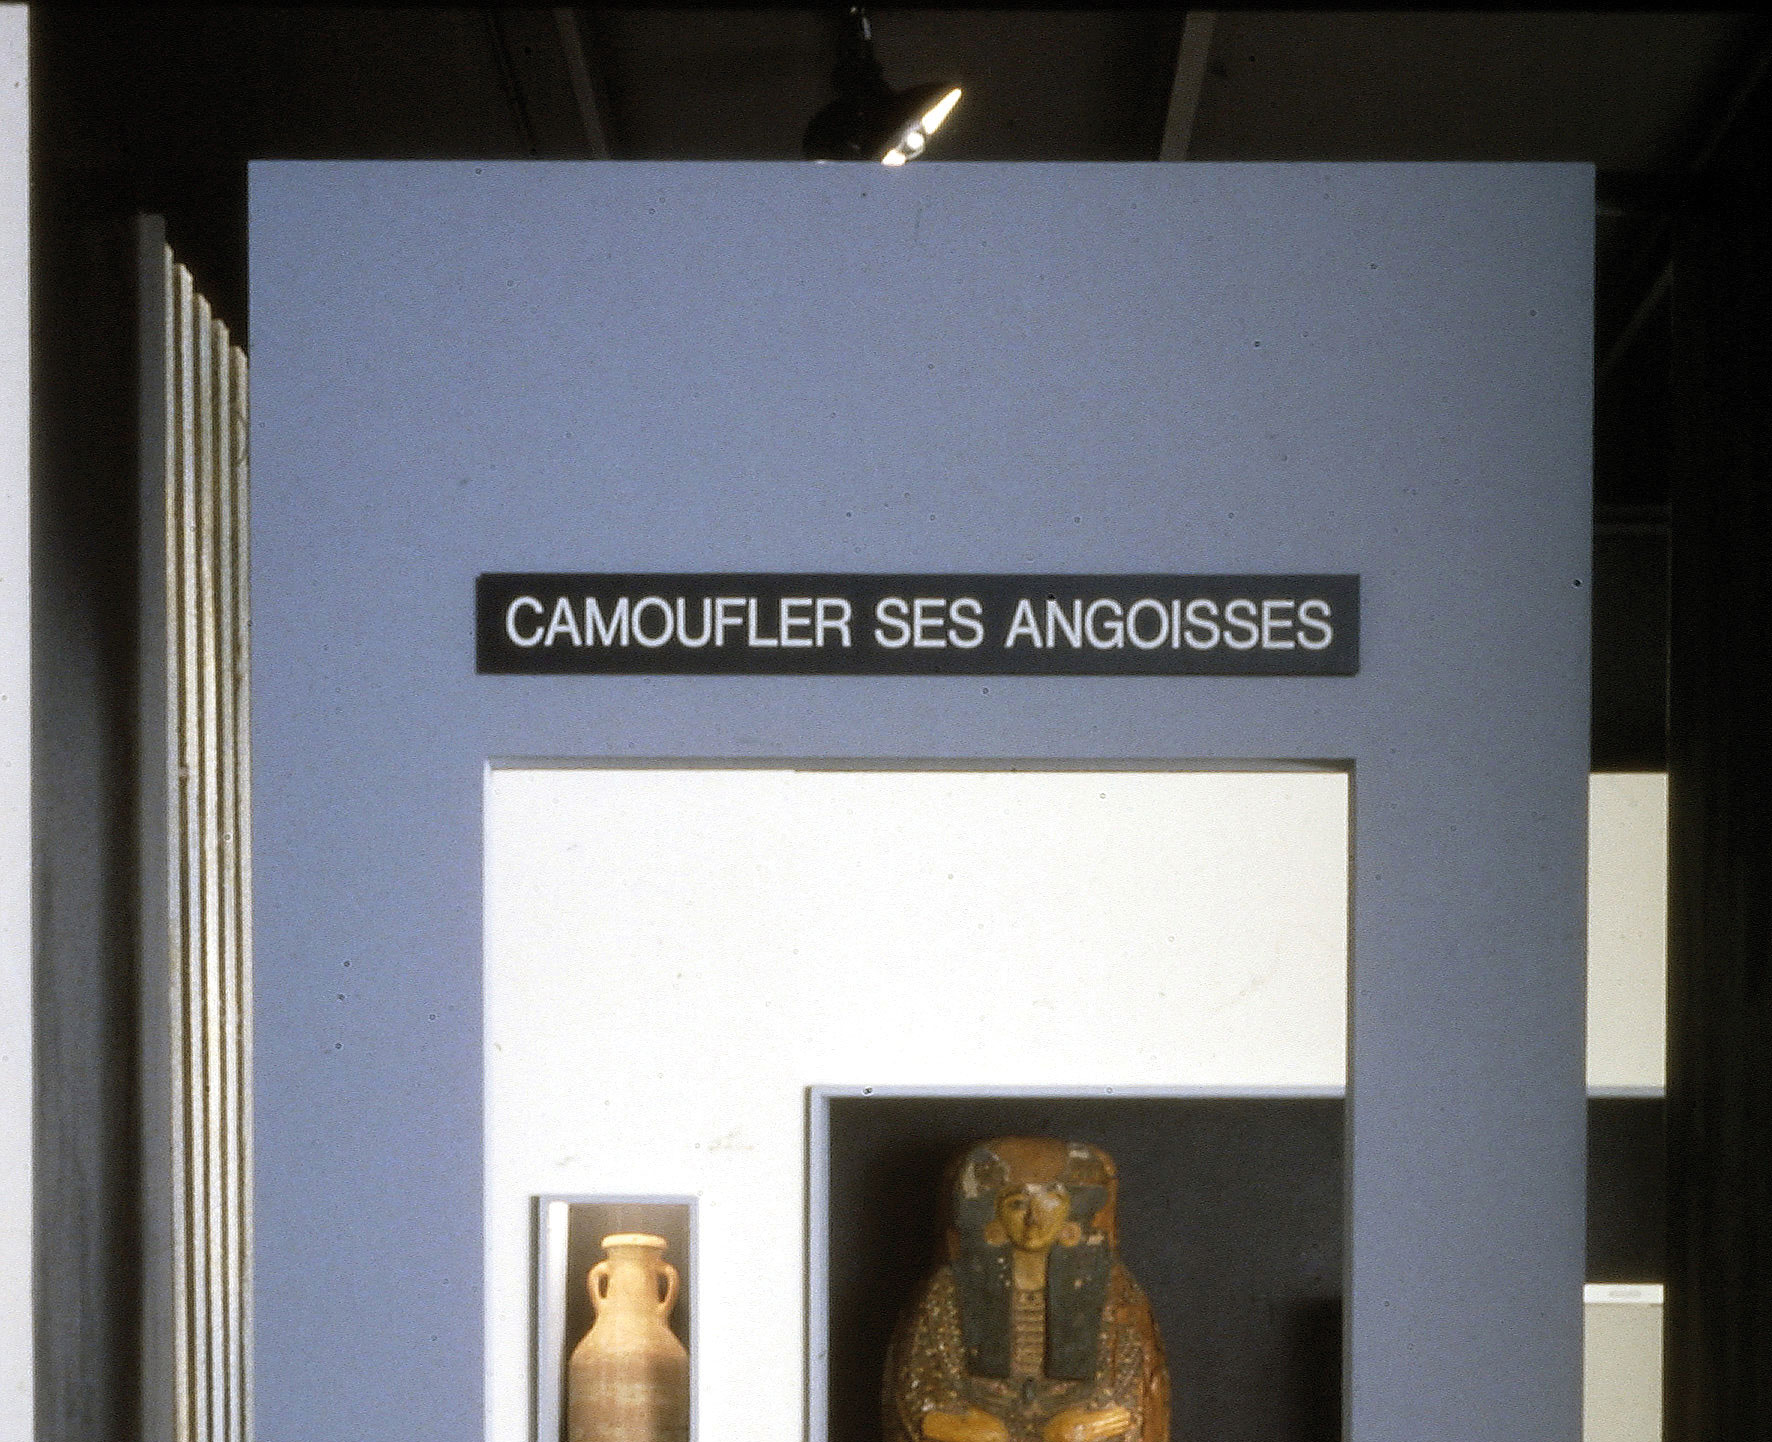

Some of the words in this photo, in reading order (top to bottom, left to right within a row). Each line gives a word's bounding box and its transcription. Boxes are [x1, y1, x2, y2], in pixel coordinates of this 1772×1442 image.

[505, 595, 853, 650] CAMOUFLER
[874, 596, 984, 649] SES
[1004, 598, 1334, 650] ANGOISSES
